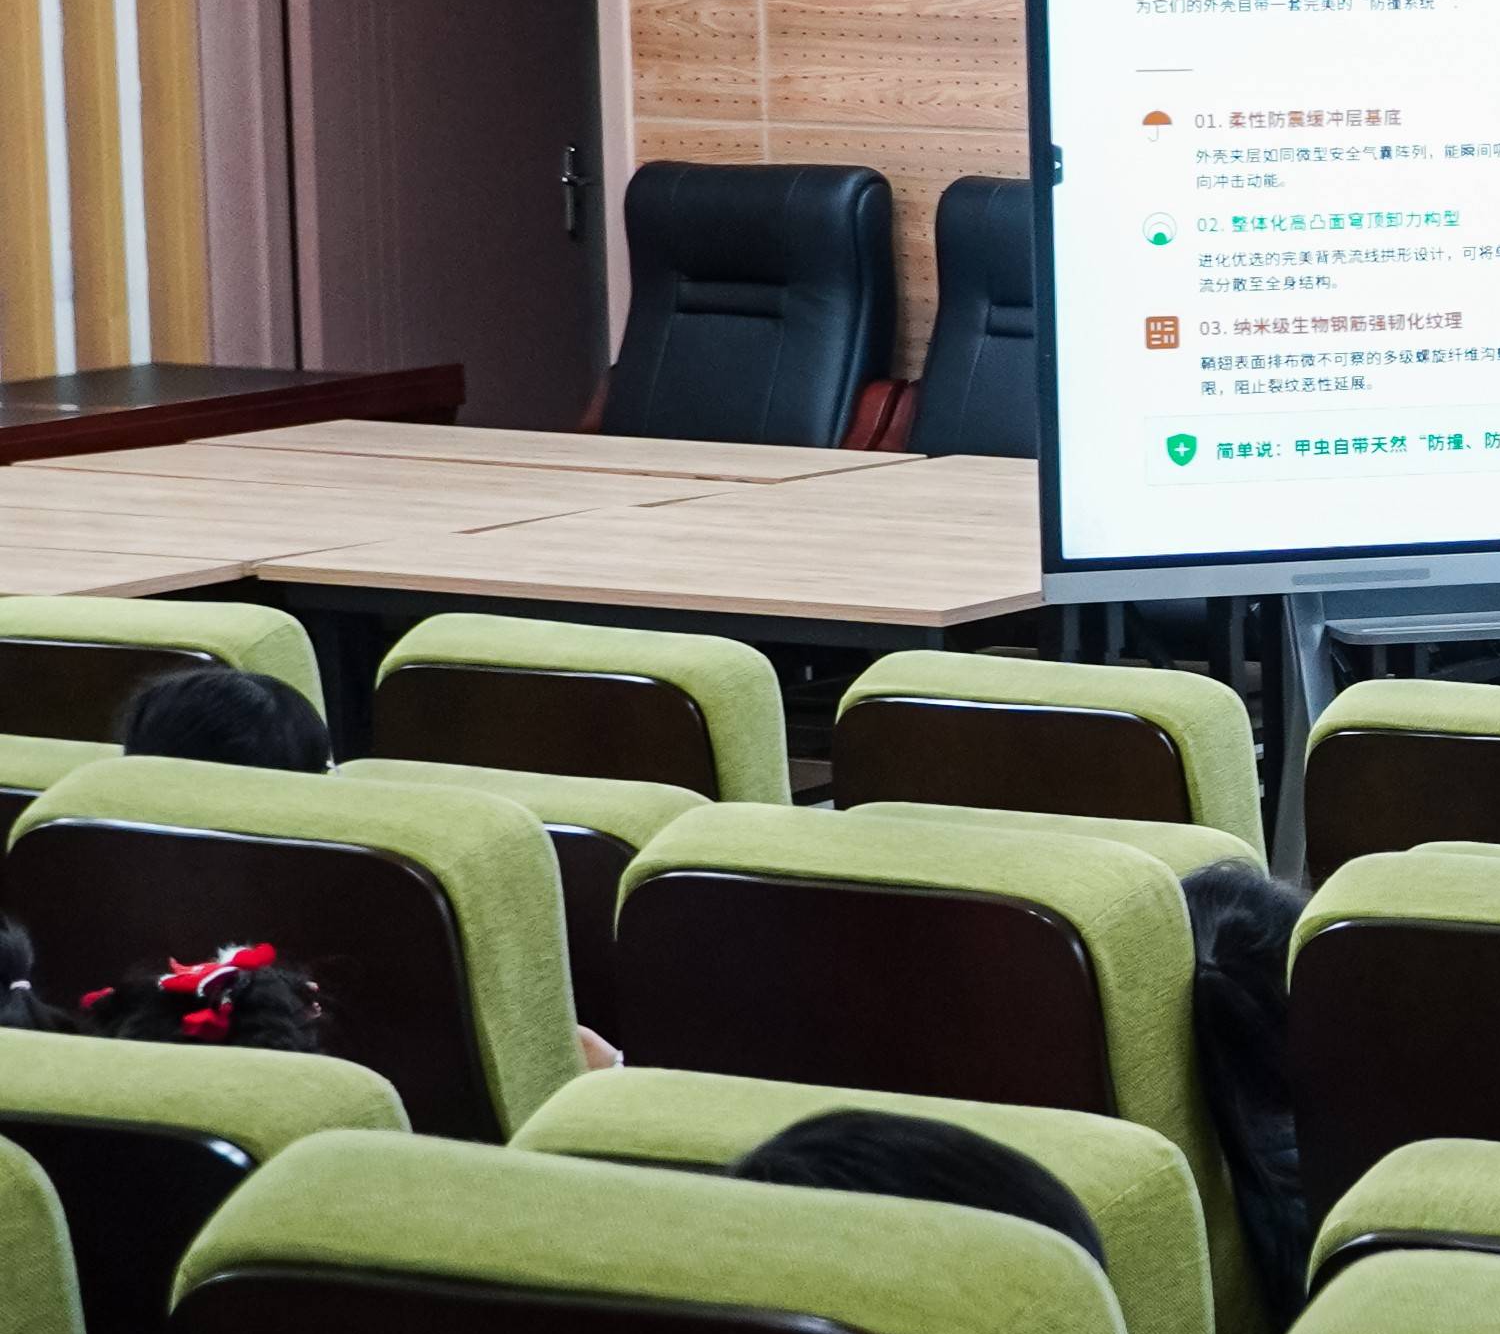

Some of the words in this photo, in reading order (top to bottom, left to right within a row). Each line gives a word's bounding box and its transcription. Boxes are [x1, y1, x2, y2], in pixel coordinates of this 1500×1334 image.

[1195, 114, 1222, 128] 01.
[1229, 109, 1401, 128] 柔性防震缓冲层基底
[1197, 218, 1224, 234] 02.
[1200, 321, 1227, 335] 03.
